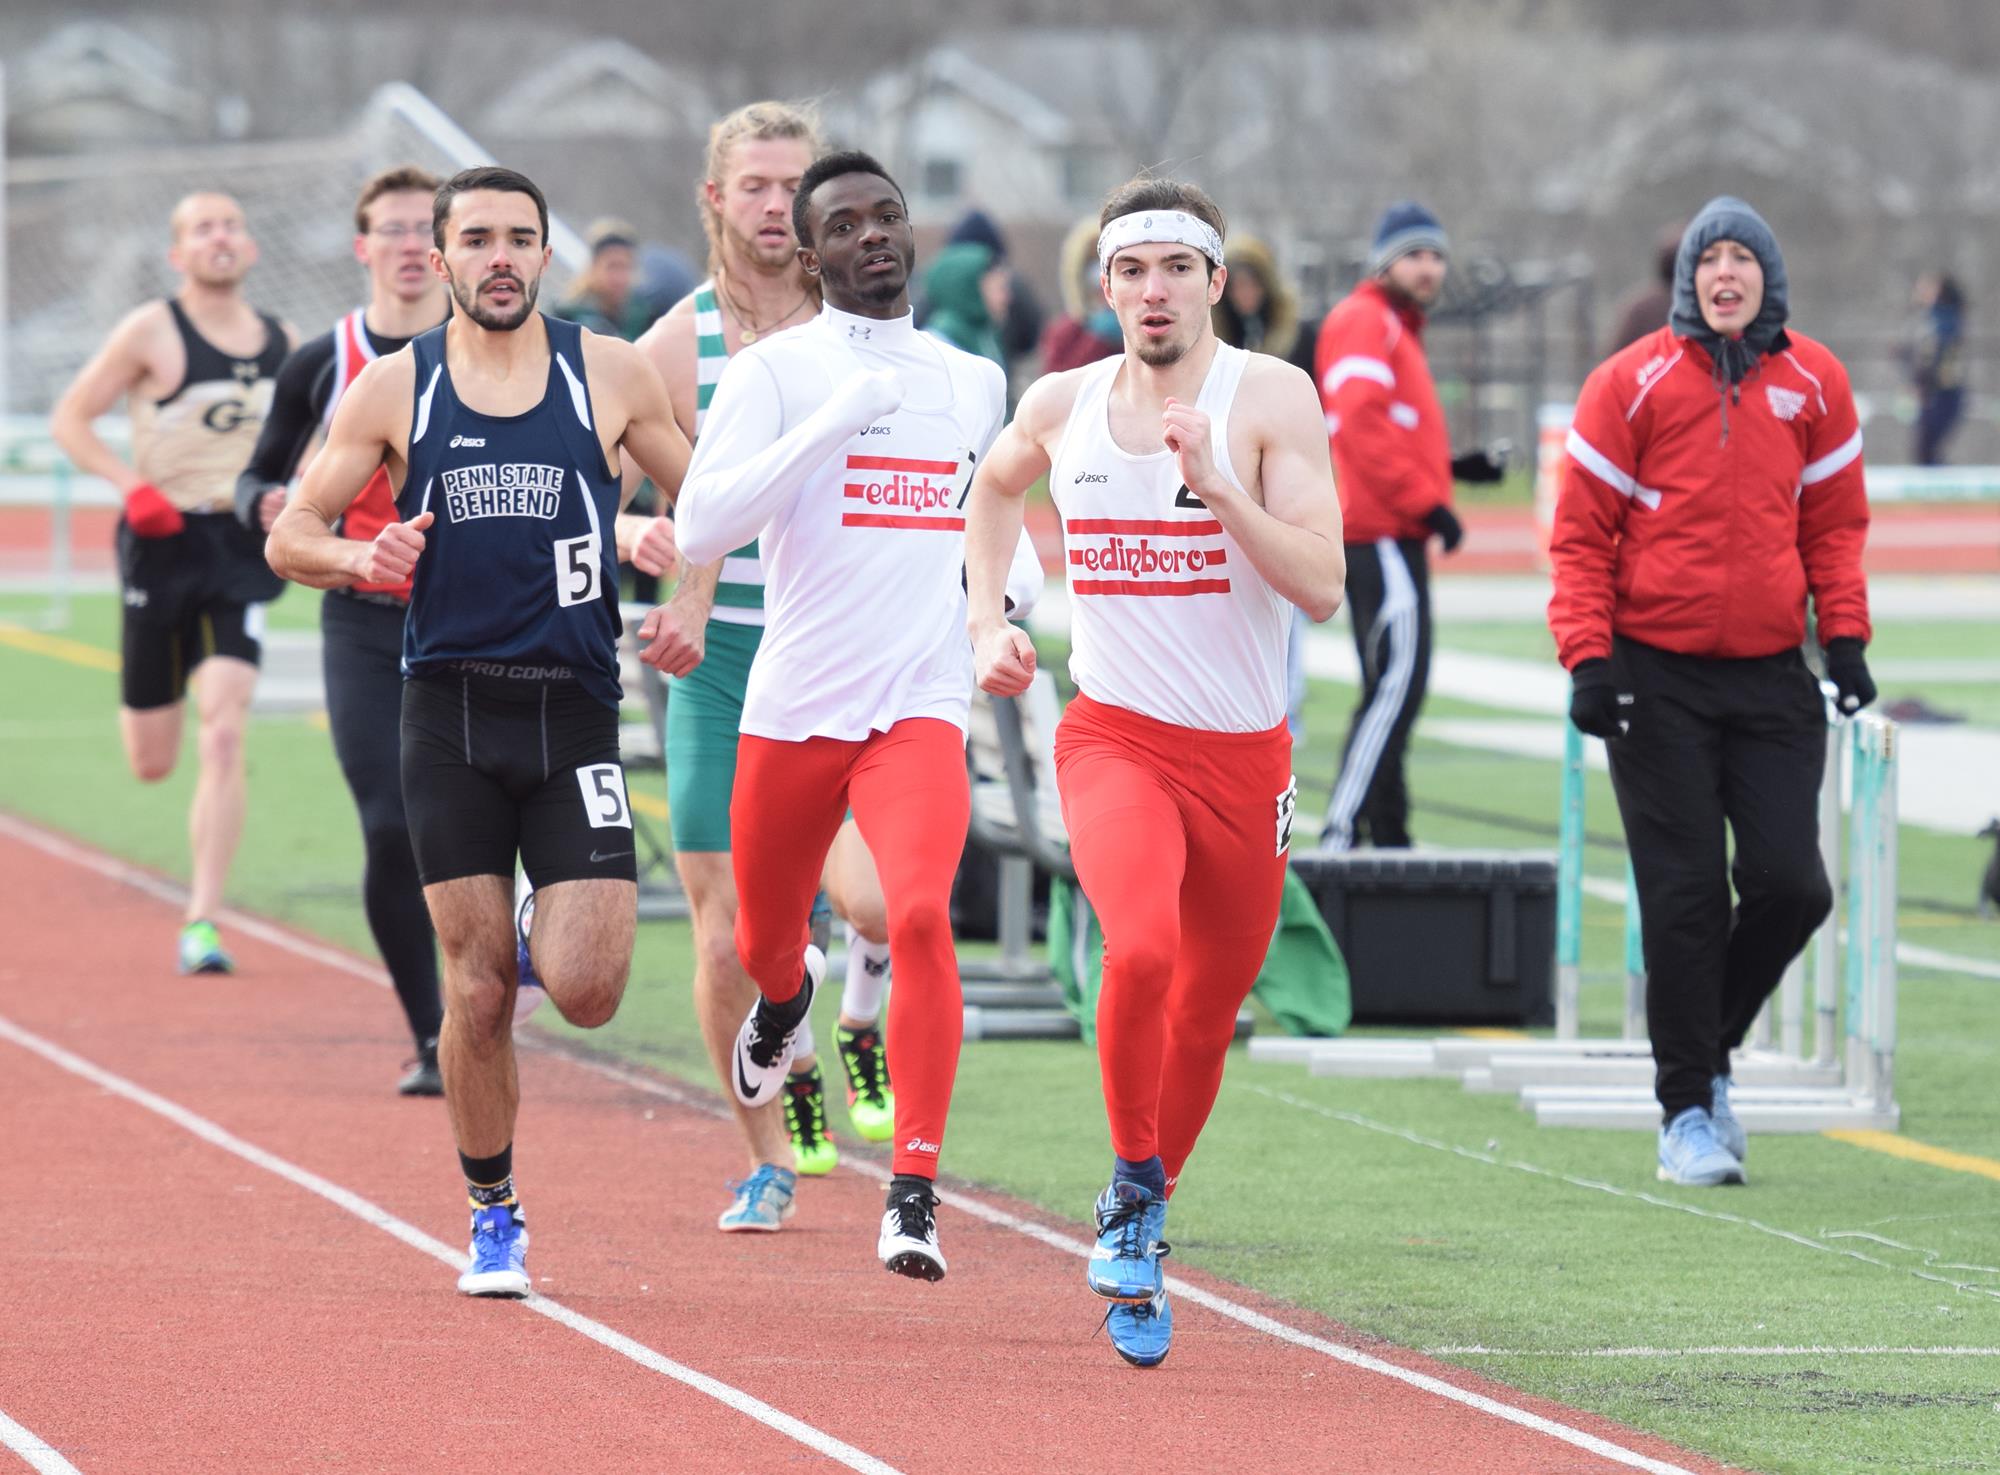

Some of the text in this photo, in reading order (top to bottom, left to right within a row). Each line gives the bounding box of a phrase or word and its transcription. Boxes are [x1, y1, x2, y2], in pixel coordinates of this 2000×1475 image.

[870, 426, 891, 435] asics
[441, 463, 564, 494] PENN STATE
[1085, 474, 1108, 484] asics
[447, 486, 560, 523] BEHREND
[568, 540, 593, 601] 5
[1084, 537, 1205, 578] edinboro
[460, 660, 506, 677] PRO
[592, 769, 623, 823] 5
